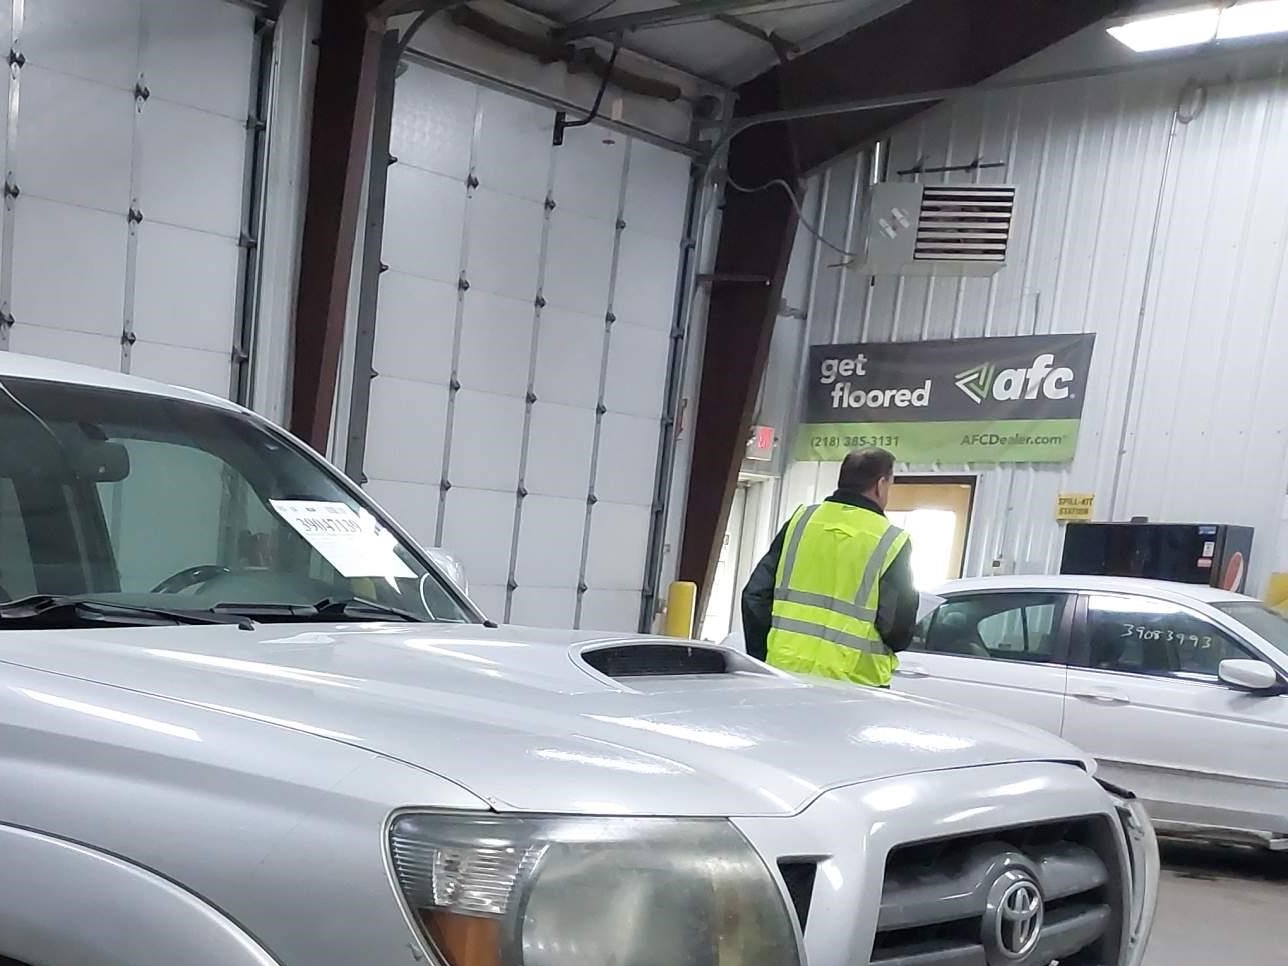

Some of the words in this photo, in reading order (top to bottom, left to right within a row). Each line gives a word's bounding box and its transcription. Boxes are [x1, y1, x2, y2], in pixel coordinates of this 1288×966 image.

[820, 354, 868, 384] get
[992, 353, 1074, 401] afc
[831, 379, 932, 408] floored
[810, 435, 840, 448] (218)
[1120, 623, 1212, 649] 39083993
